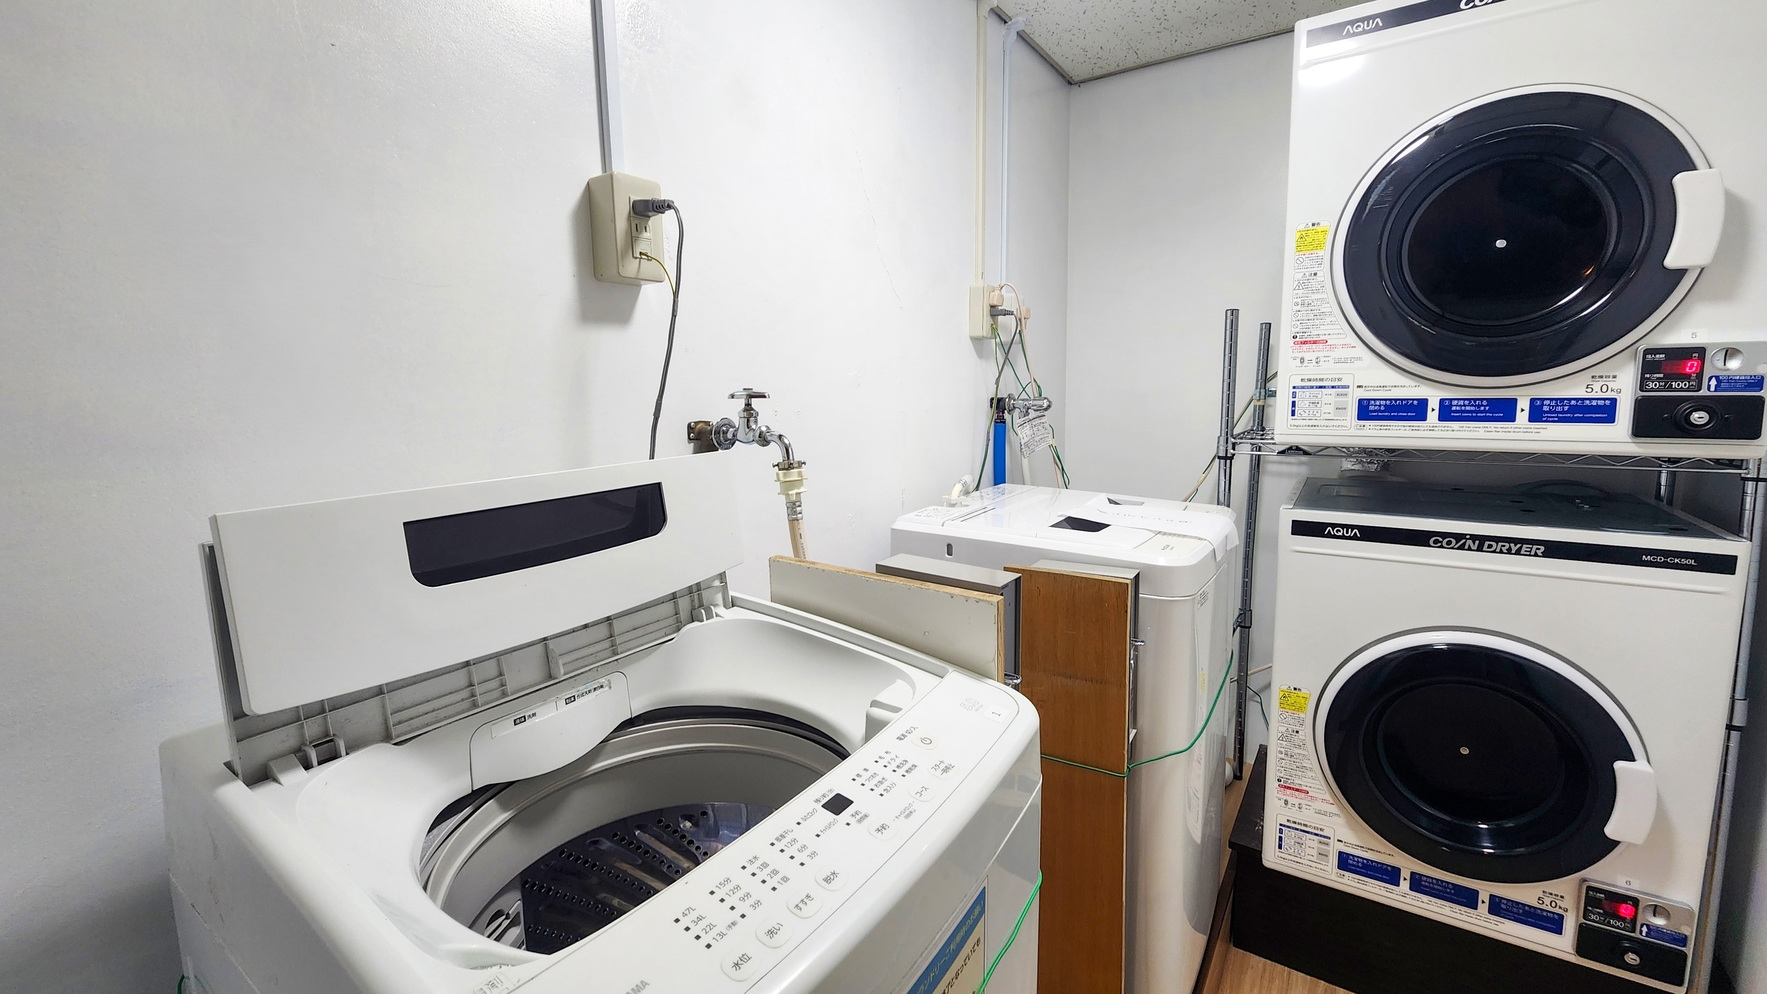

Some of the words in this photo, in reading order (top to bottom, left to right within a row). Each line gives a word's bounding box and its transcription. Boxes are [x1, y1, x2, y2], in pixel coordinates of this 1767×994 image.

[1343, 18, 1382, 36] AQUA
[1686, 362, 1697, 372] 0
[1324, 526, 1360, 537] AQUA
[1429, 534, 1480, 550] COIN
[1482, 541, 1545, 556] DRYER
[1642, 555, 1698, 565] MCD-CK50L
[915, 786, 929, 797] コース
[850, 810, 862, 819] 予約
[875, 823, 890, 834] 予約
[784, 838, 799, 849] 12分
[797, 844, 808, 853] 6分
[807, 851, 818, 860] 3分
[756, 861, 770, 872] 3回
[767, 868, 780, 879] 2回
[823, 870, 840, 885] 脱水
[716, 877, 732, 890] 15分
[777, 875, 790, 886] 1回
[726, 884, 742, 898] 12分
[739, 892, 752, 903] 9分
[794, 893, 814, 912] すすぎ
[749, 900, 763, 910] 3分
[682, 906, 696, 918] 47L
[691, 914, 706, 926] 34L
[701, 922, 717, 935] 22L
[764, 923, 783, 939] 洗い
[712, 931, 727, 942] 13L
[732, 953, 752, 971] 水位
